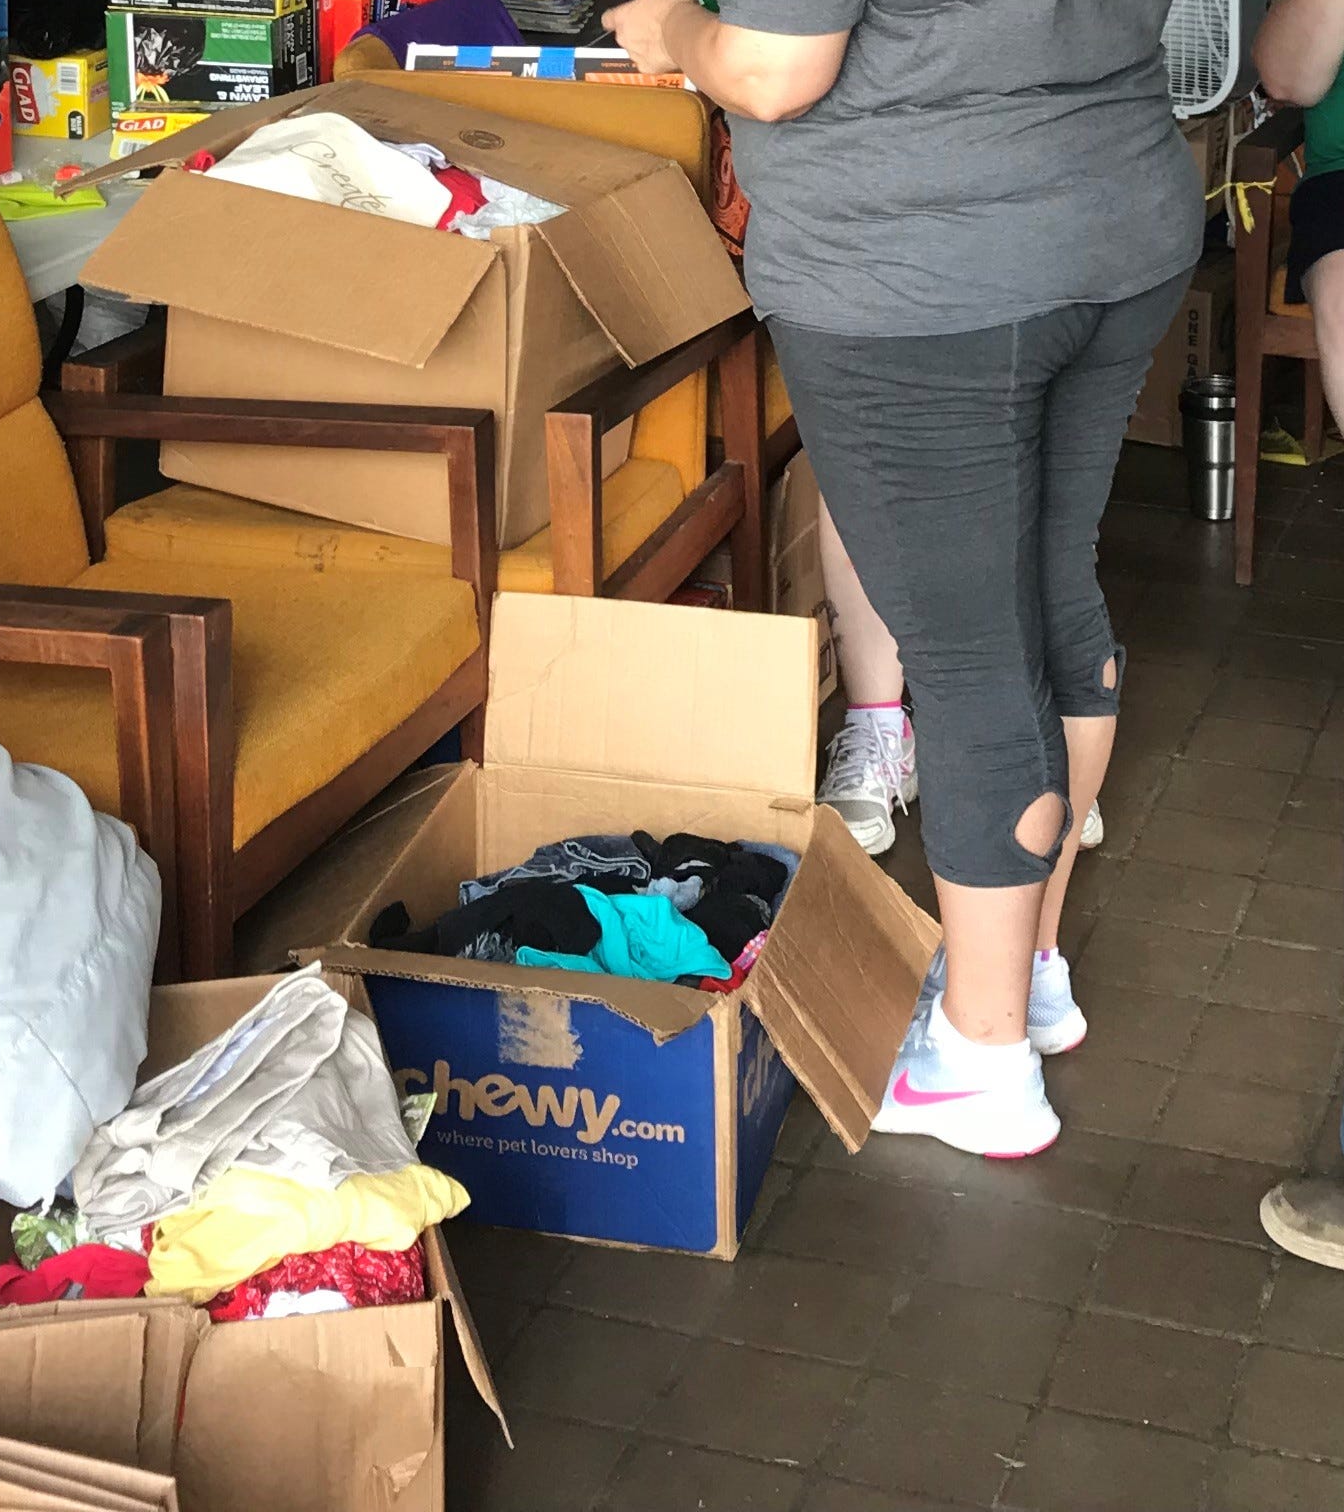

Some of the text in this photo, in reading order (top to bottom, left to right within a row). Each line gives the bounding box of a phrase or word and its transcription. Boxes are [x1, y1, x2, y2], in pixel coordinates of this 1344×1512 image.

[209, 73, 270, 83] DRAWSTRING
[234, 83, 270, 92] LEAF
[13, 68, 35, 121] GLAD
[230, 91, 270, 102] LAWN
[119, 119, 165, 132] GLAD
[290, 141, 392, 213] Create
[436, 1130, 639, 1169] where pet lovers shop
